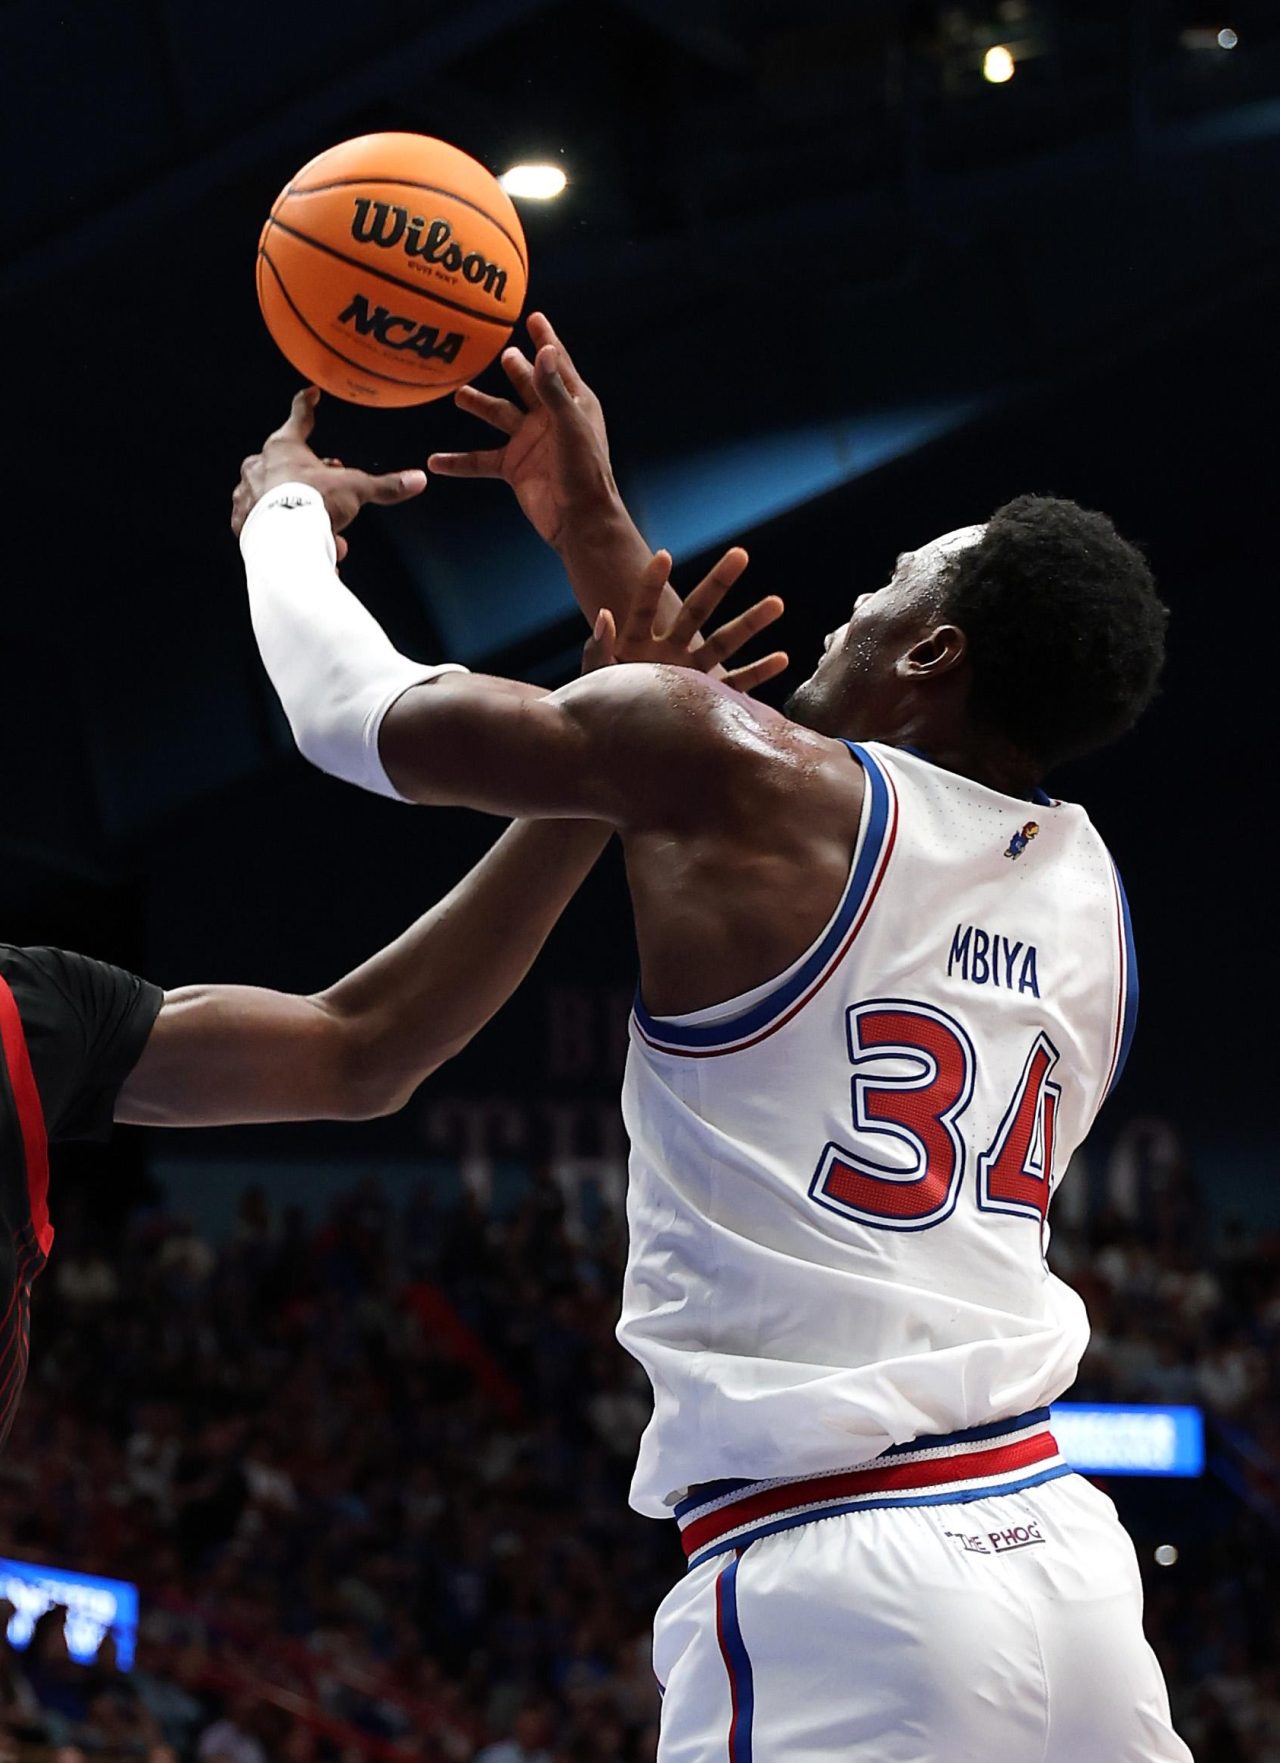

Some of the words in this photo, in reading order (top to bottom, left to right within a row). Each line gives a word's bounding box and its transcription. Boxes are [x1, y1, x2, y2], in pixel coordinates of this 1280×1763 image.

[351, 197, 508, 303] Wilson
[337, 293, 466, 364] NCAA
[947, 923, 1040, 999] MBIYA
[807, 997, 1062, 1233] 34
